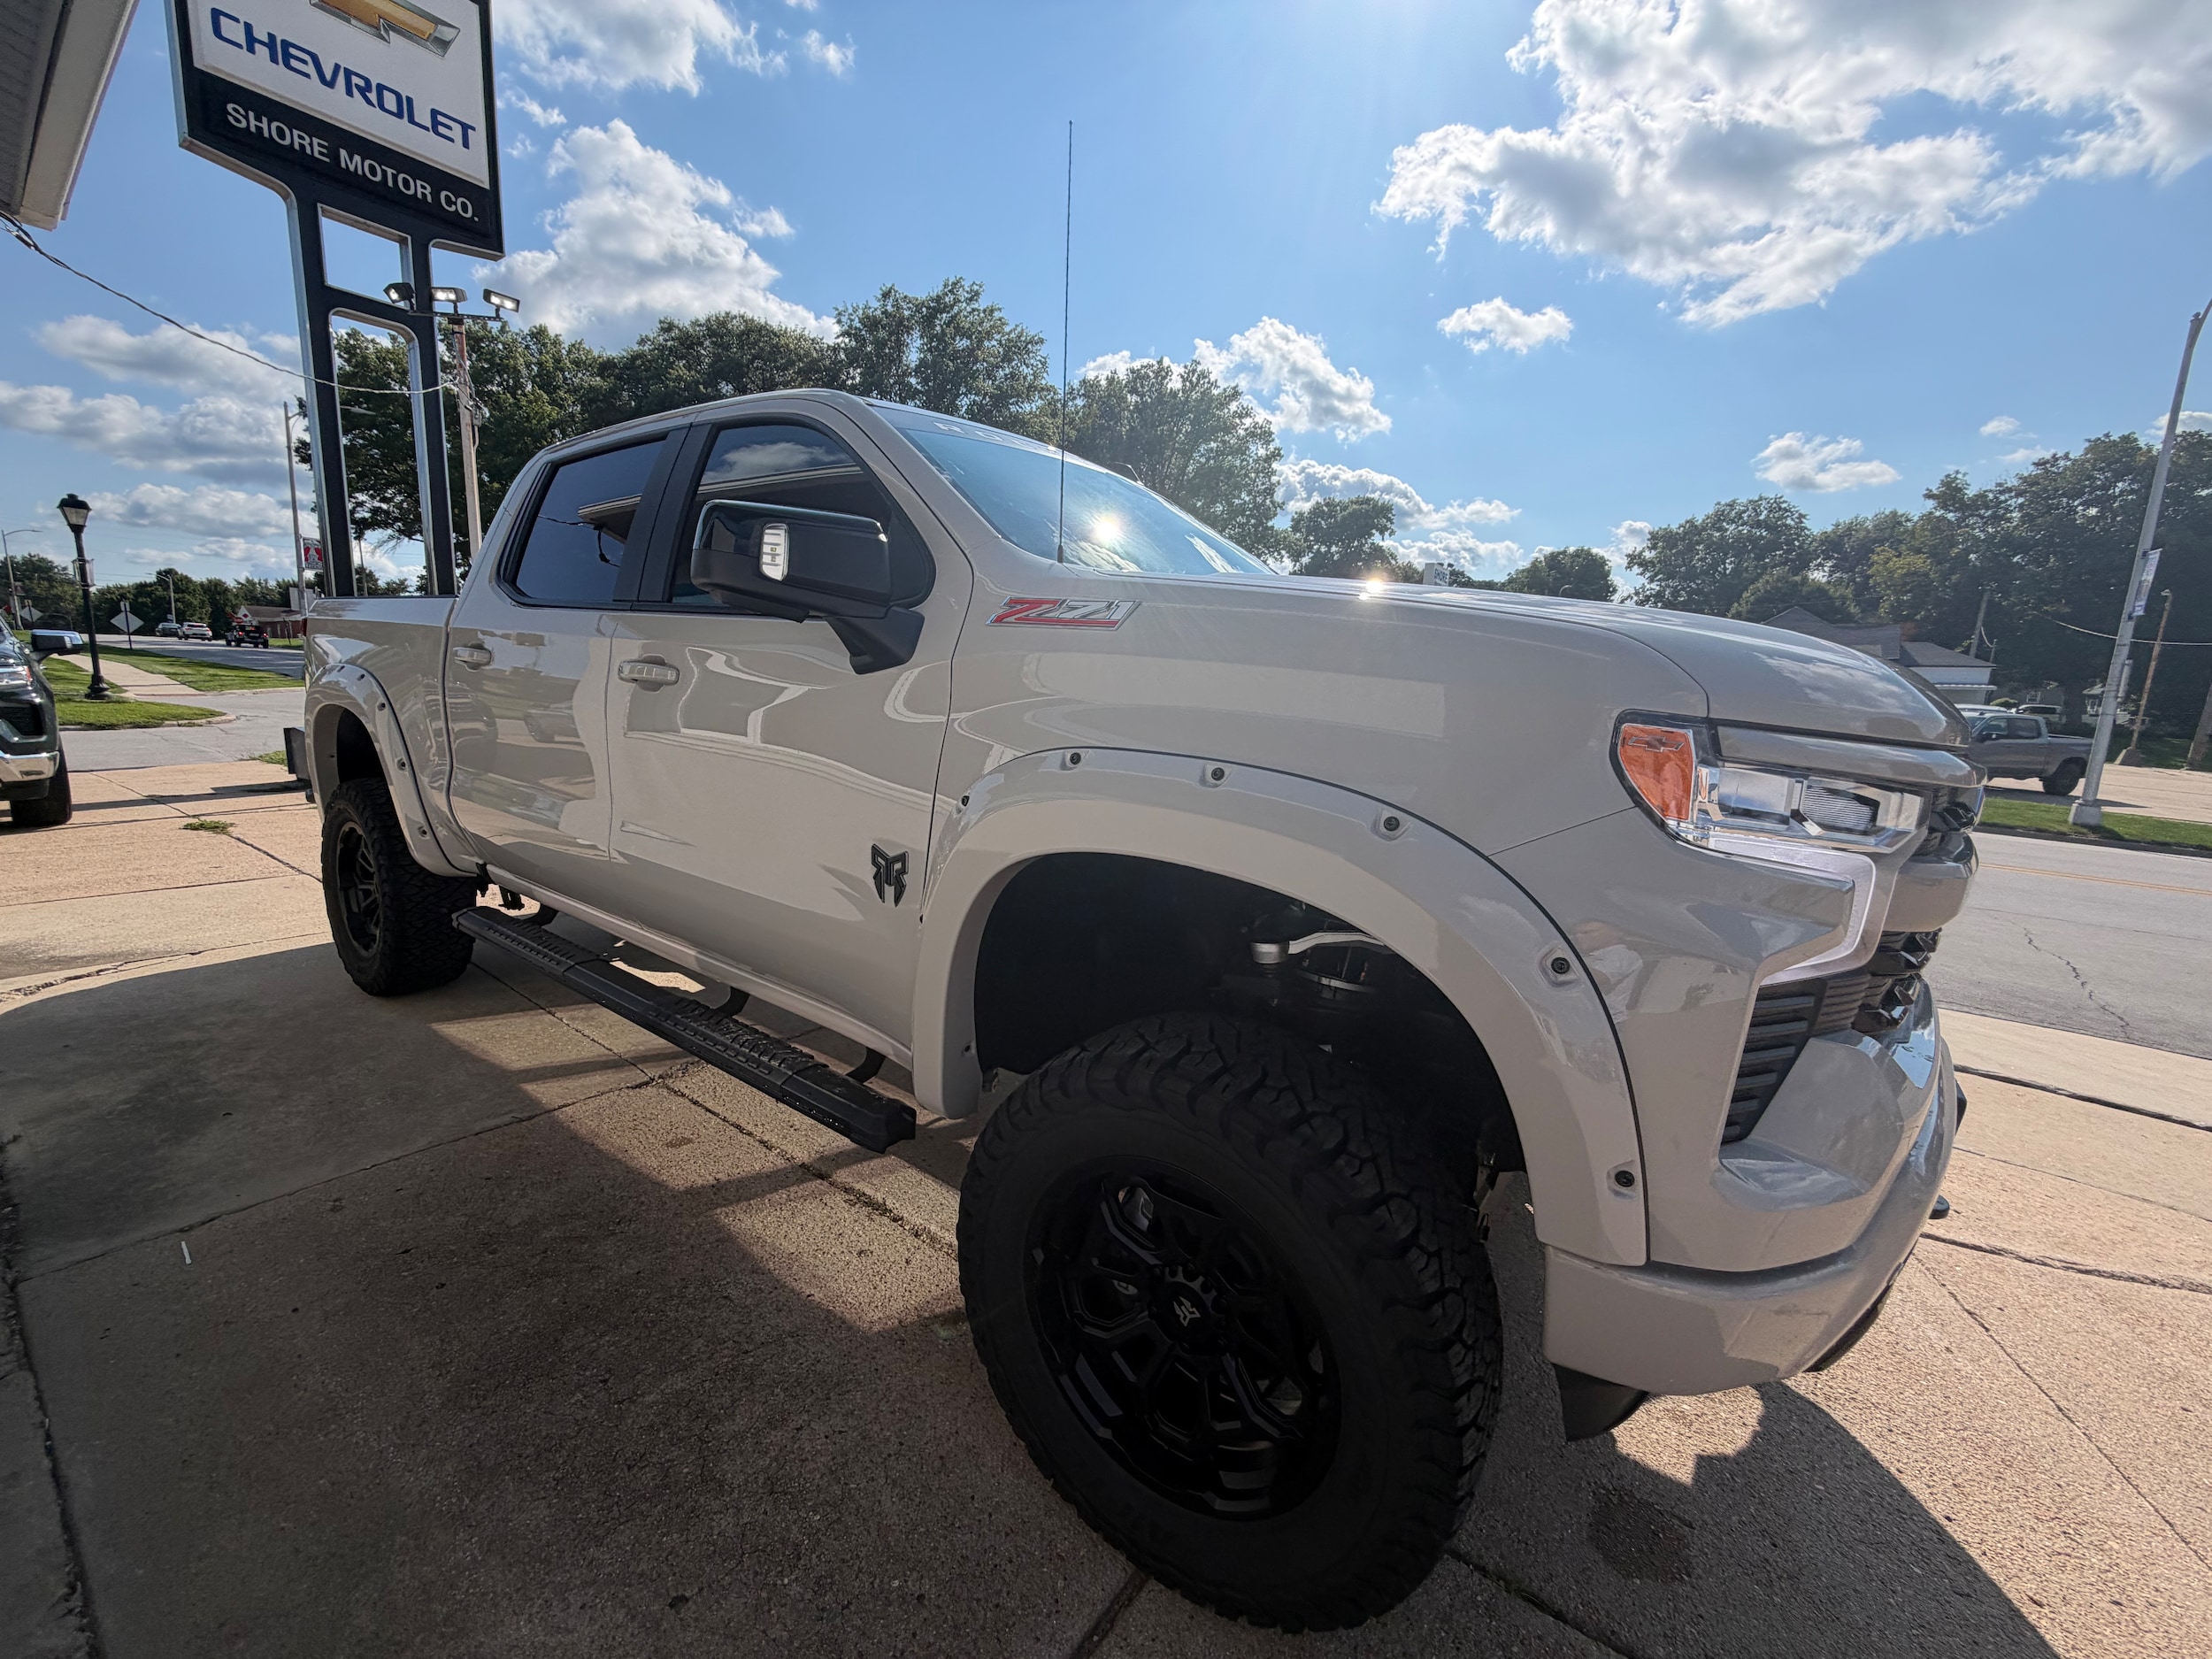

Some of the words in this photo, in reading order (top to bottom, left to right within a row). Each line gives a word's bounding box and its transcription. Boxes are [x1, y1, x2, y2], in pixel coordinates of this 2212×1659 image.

[211, 7, 476, 150] CHEVROLET
[226, 103, 331, 163] SHORE
[339, 148, 433, 204] MOTOR
[440, 190, 480, 222] CO.
[986, 596, 1141, 631] Z71
